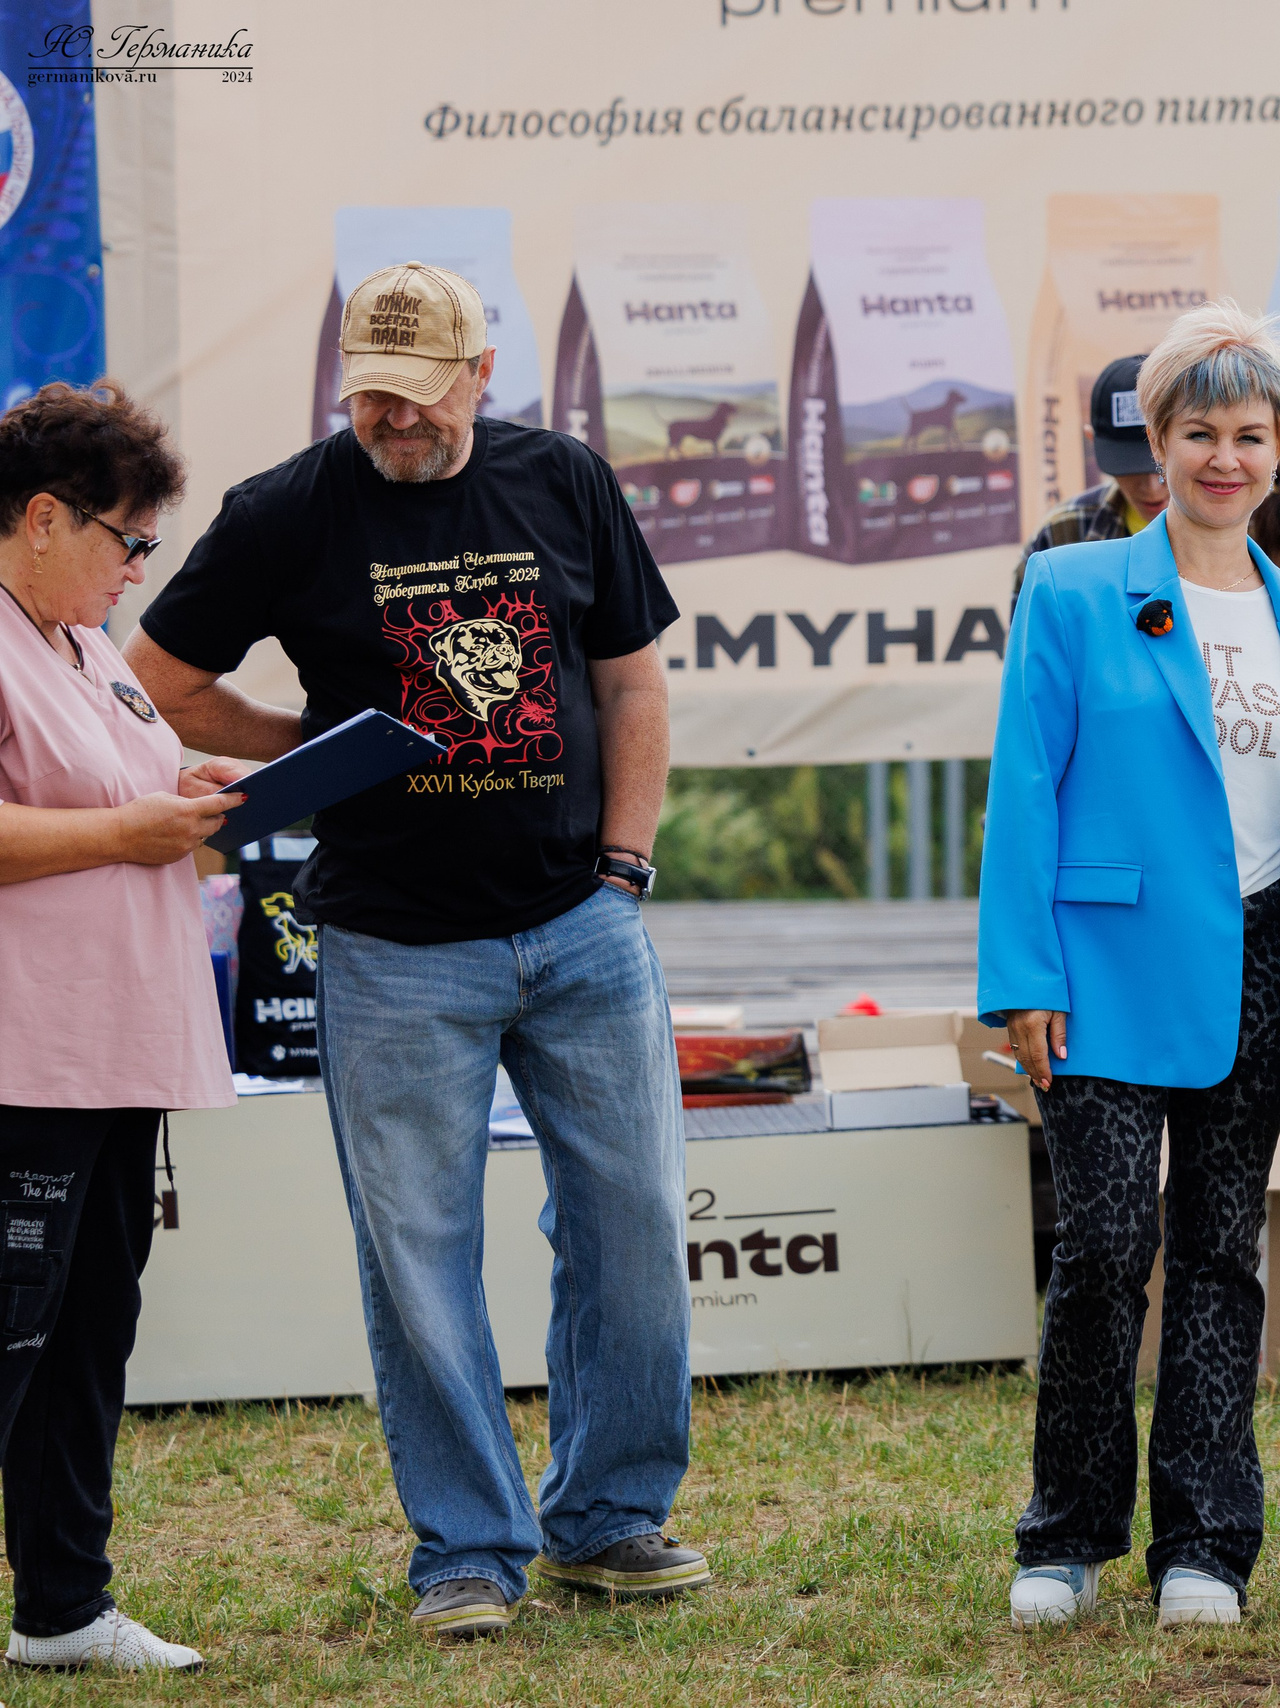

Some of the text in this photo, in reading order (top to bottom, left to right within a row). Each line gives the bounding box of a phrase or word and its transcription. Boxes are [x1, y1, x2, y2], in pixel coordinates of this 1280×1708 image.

[423, 97, 683, 148] Философия
[697, 95, 1144, 140] сбалансированного
[373, 294, 422, 315] МУЖИК
[624, 300, 738, 324] Hanta
[860, 294, 975, 318] Hanta
[369, 313, 420, 329] ВСЕГДА
[370, 327, 416, 347] ПРАВ!
[370, 551, 535, 581] Национальный Чемпионат
[373, 582, 450, 607] Победитель
[454, 572, 498, 594] Клуба
[407, 769, 565, 798] XXVI Кубок Твери
[687, 1228, 839, 1281] nta
[692, 1291, 758, 1308] mium
